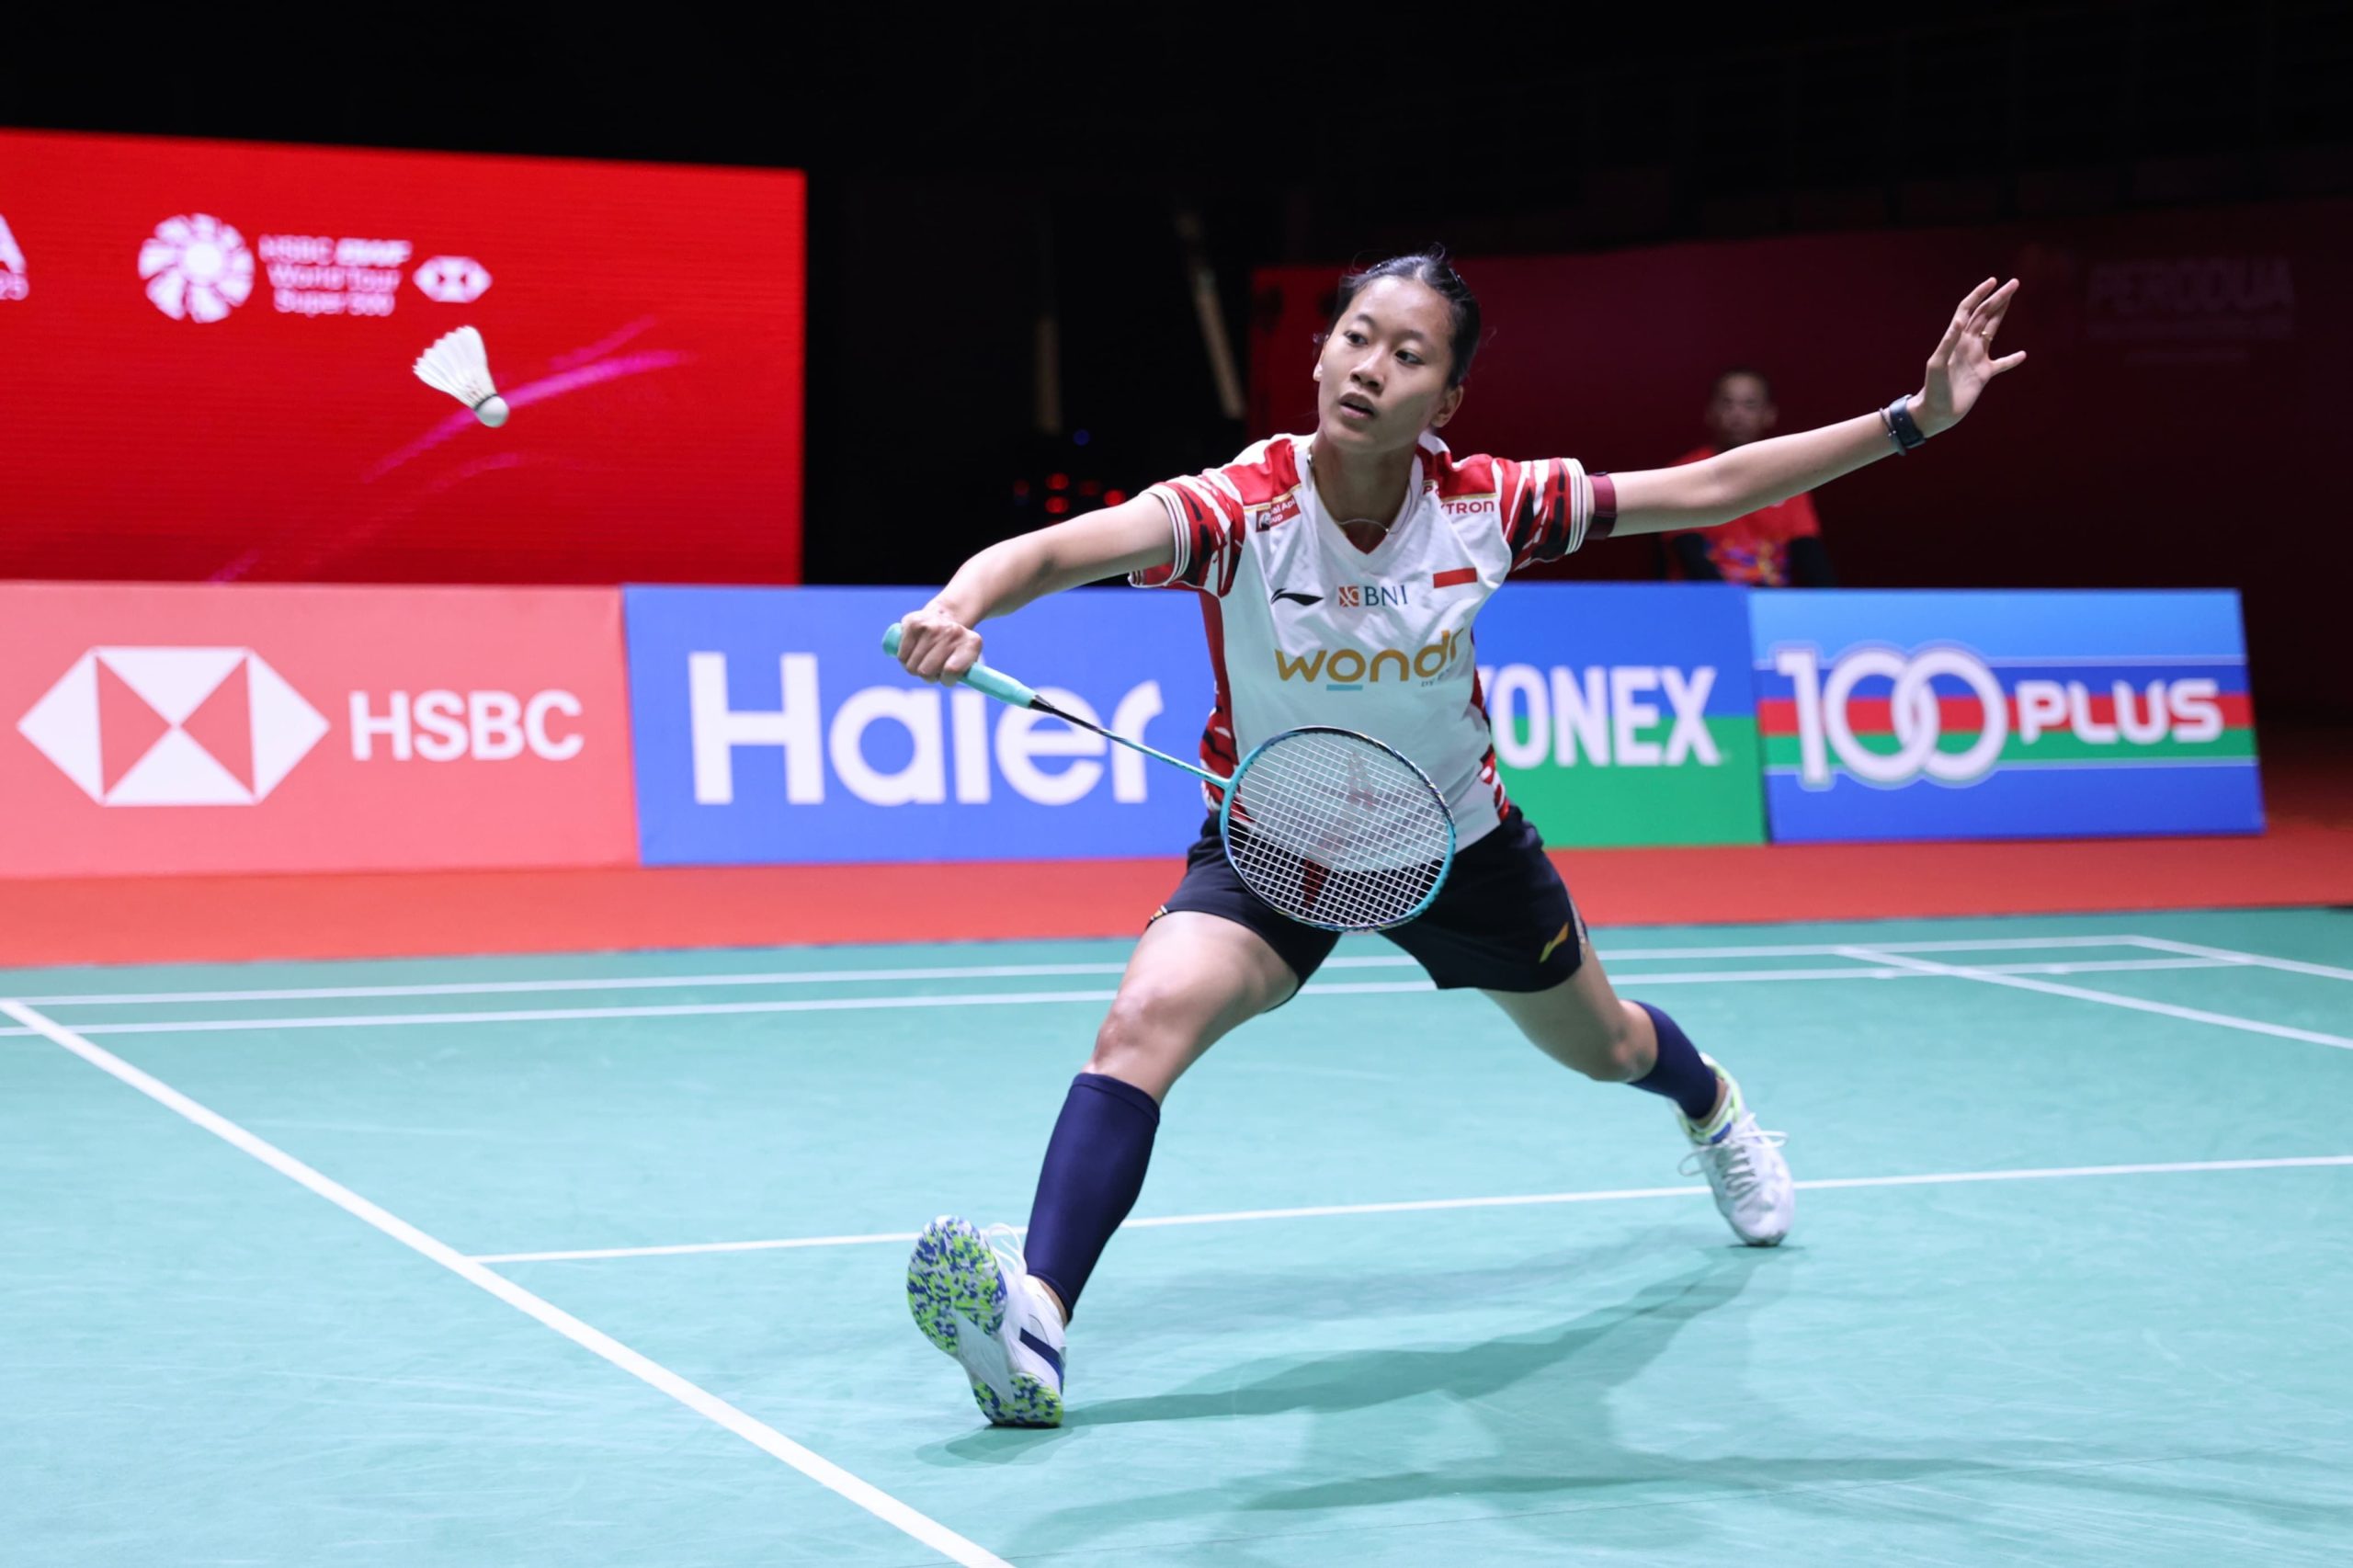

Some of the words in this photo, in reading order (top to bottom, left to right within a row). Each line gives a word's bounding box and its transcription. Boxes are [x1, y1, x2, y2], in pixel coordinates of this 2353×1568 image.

[1364, 585, 1409, 607] BNI
[348, 689, 584, 761] HSBC
[688, 652, 1164, 807] Haier
[1776, 648, 2009, 782] 100
[2015, 678, 2224, 745] PLUS
